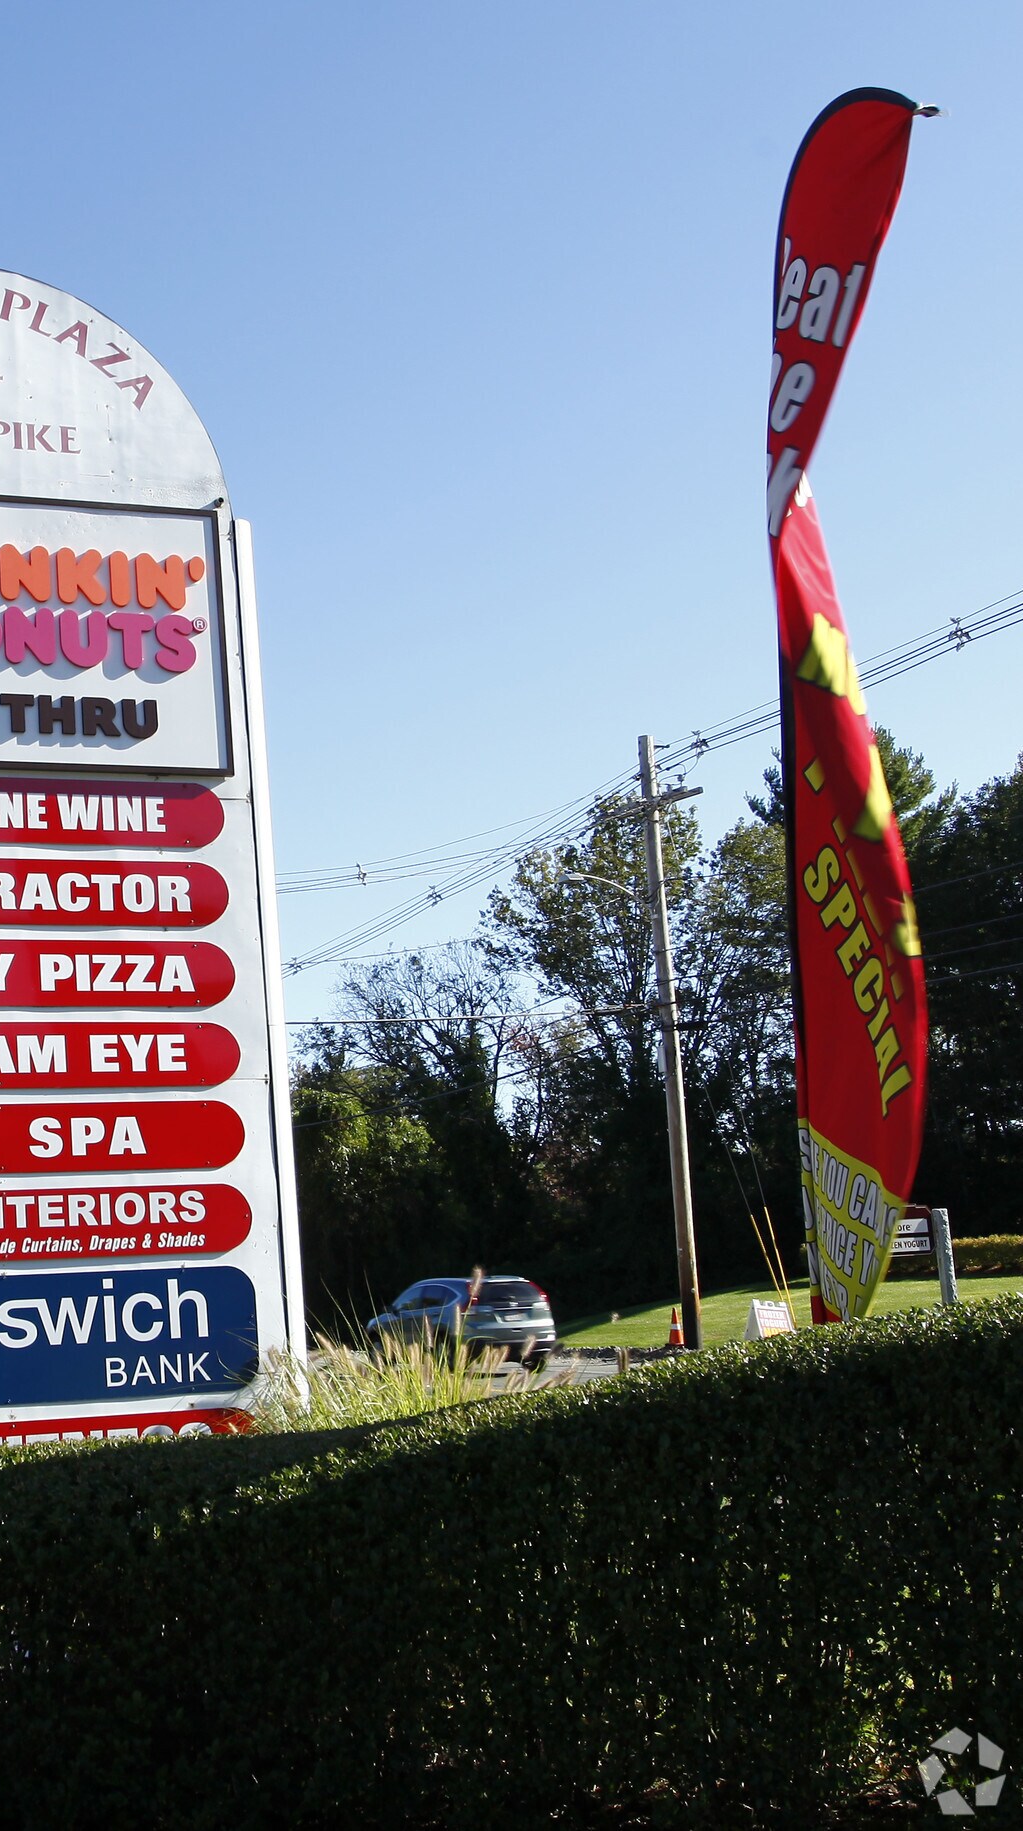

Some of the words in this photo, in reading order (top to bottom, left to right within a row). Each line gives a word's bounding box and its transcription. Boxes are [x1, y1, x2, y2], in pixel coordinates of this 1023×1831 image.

[779, 236, 866, 348] eat
[0, 693, 159, 739] THRU
[56, 794, 167, 833] WINE
[39, 953, 196, 993] PIZZA
[803, 846, 914, 1119] SPECIAL
[89, 1033, 188, 1073] EYE
[28, 1116, 147, 1158] SPA
[21, 1235, 83, 1254] Curtains,
[89, 1234, 136, 1251] Drapes
[142, 1234, 152, 1248] &
[158, 1231, 205, 1249] Shades
[904, 1240, 927, 1248] YOGURT
[105, 1351, 212, 1388] BANK
